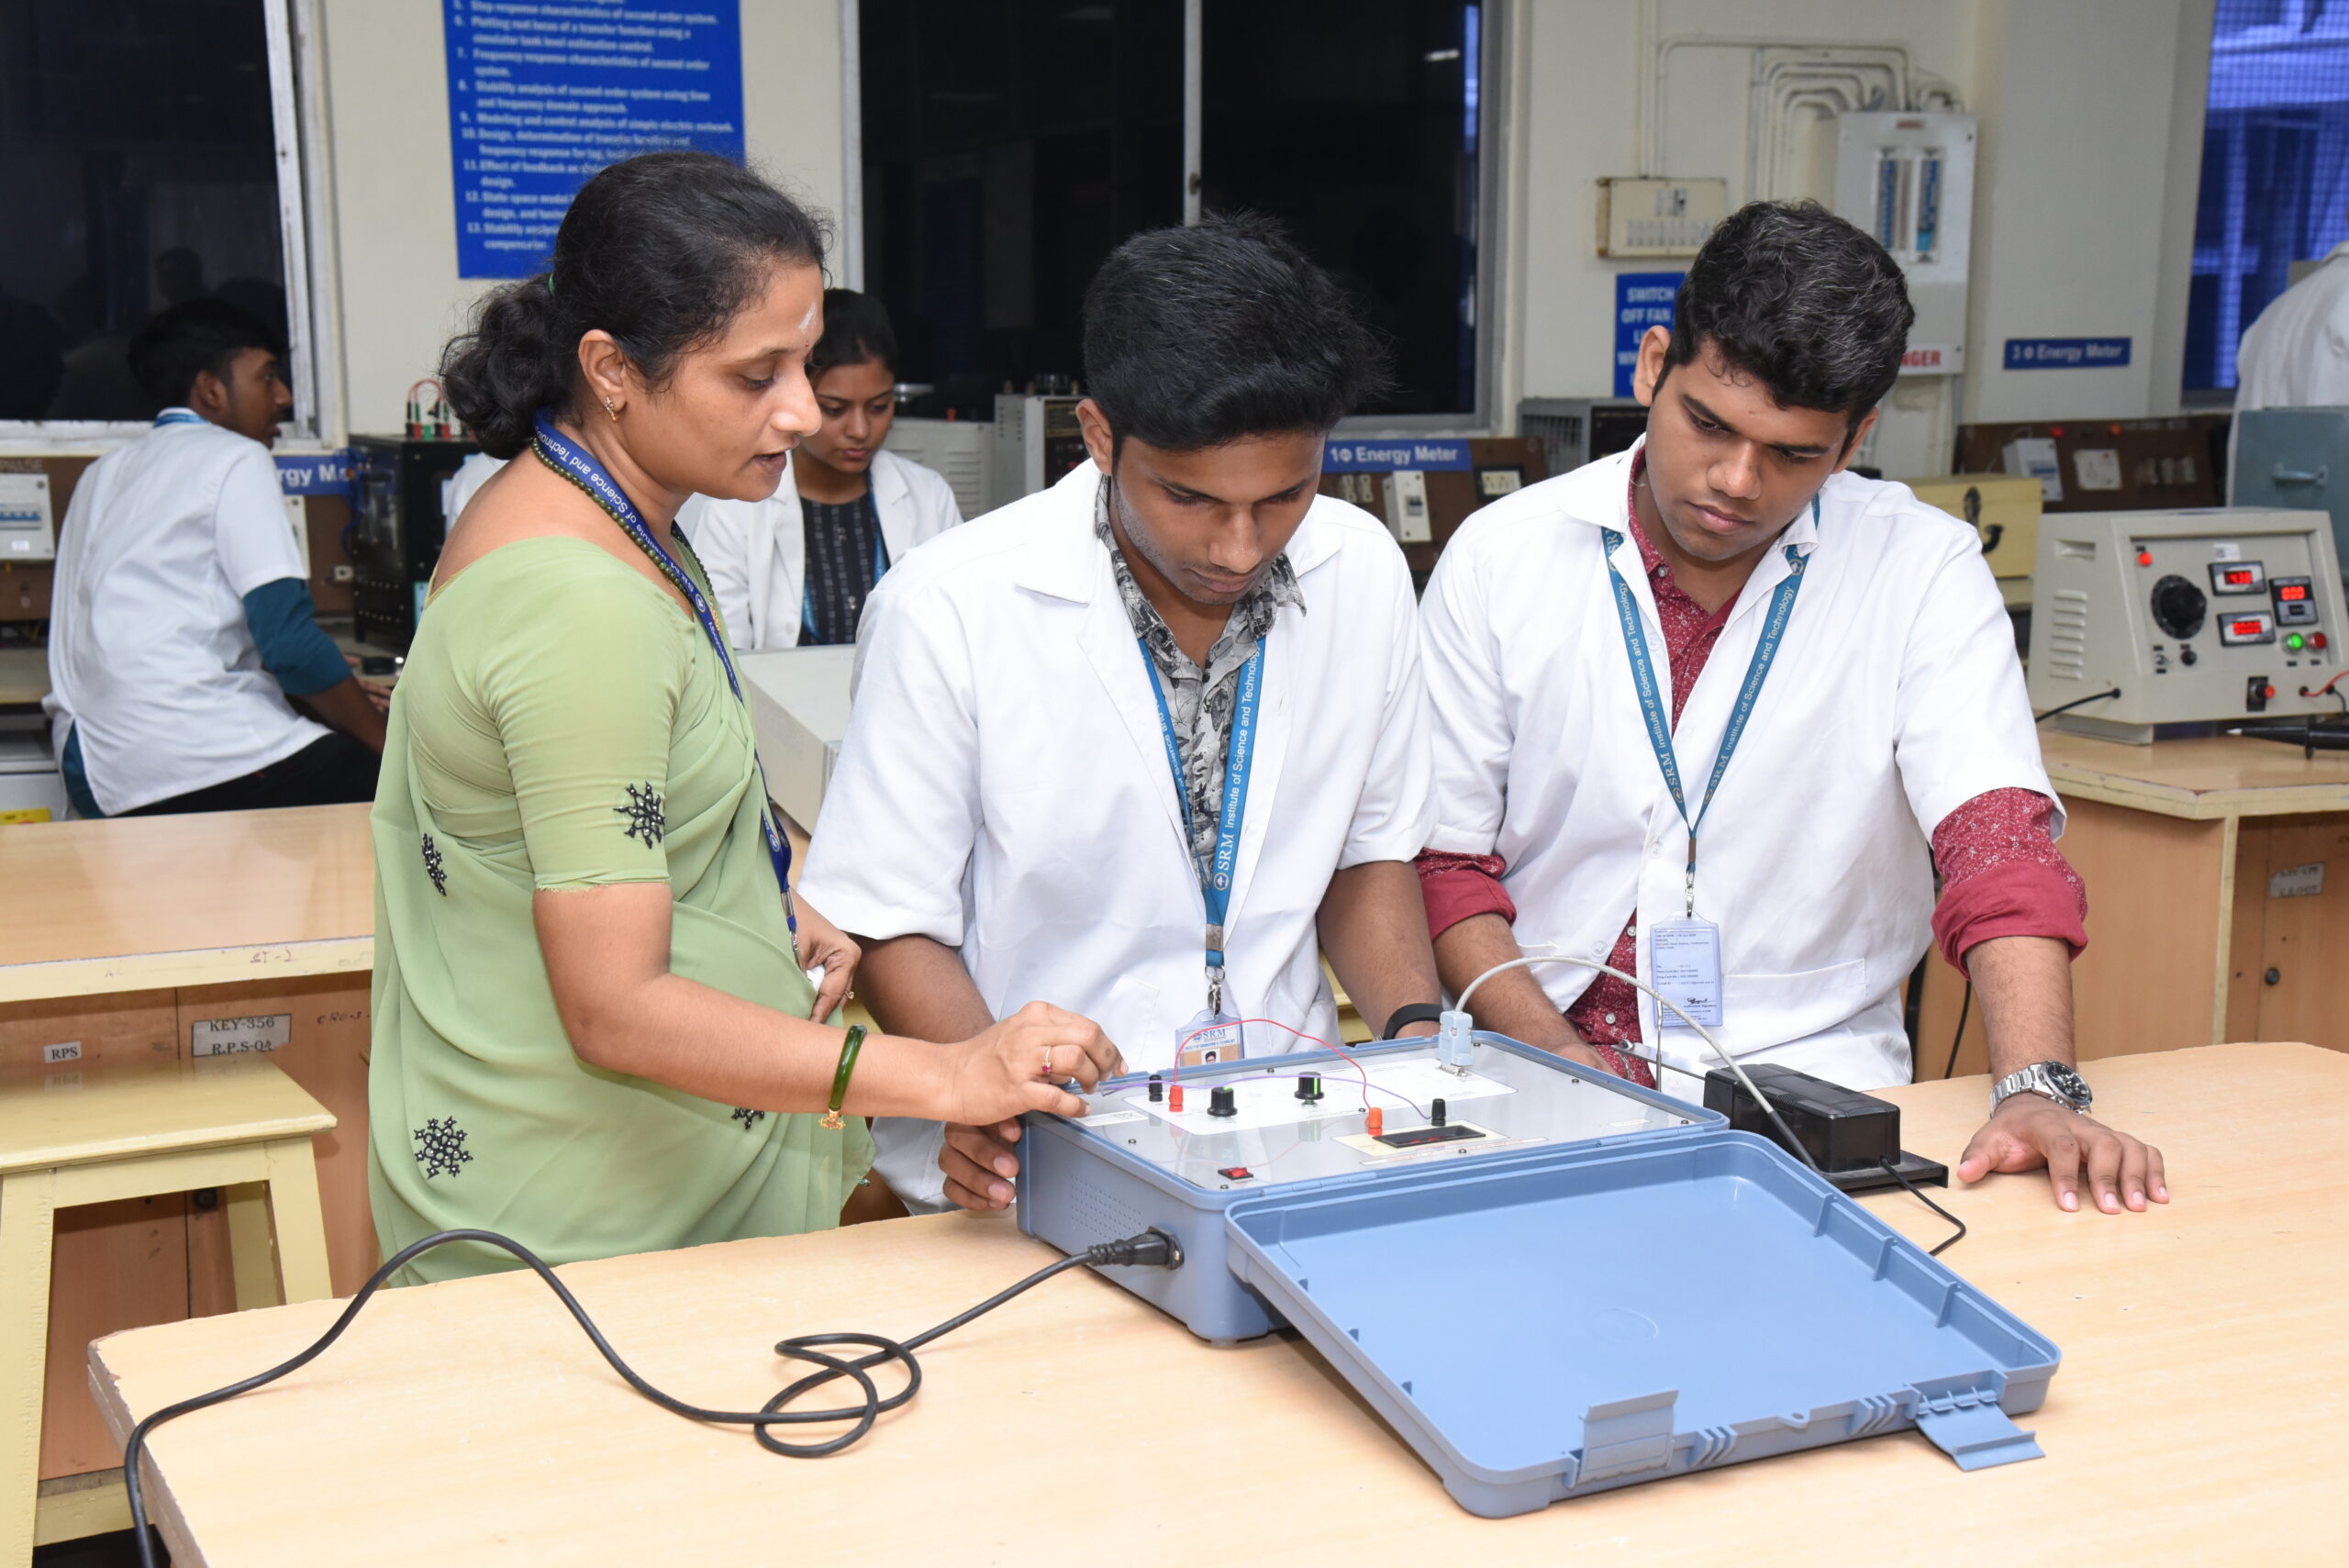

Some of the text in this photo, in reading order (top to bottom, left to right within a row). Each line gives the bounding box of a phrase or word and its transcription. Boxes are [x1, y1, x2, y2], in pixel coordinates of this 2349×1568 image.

[496, 4, 539, 14] response
[525, 53, 567, 63] response
[524, 117, 542, 125] and
[526, 226, 560, 238] analysi
[1626, 287, 1675, 303] SWITCH
[1620, 308, 1671, 324] OFF FAN
[1899, 350, 1941, 367] NGER
[2012, 346, 2020, 360] 3
[2037, 344, 2082, 362] Energy
[2086, 343, 2123, 359] Meter
[1356, 447, 1411, 465] Energy
[1415, 446, 1458, 462] Meter
[569, 455, 592, 475] and
[278, 468, 313, 488] rgy
[590, 473, 629, 514] Science
[625, 511, 637, 524] of
[1619, 582, 1678, 787] SRM Institute of Science and Technology
[1709, 585, 1795, 787] SRM Institute of Science and Technology
[1164, 734, 1181, 775] Science
[1218, 646, 1261, 872] SRM Institute of Science and Technology
[209, 1016, 275, 1032] KEY-356
[1202, 1029, 1226, 1040] SRM
[51, 1046, 78, 1060] RPS
